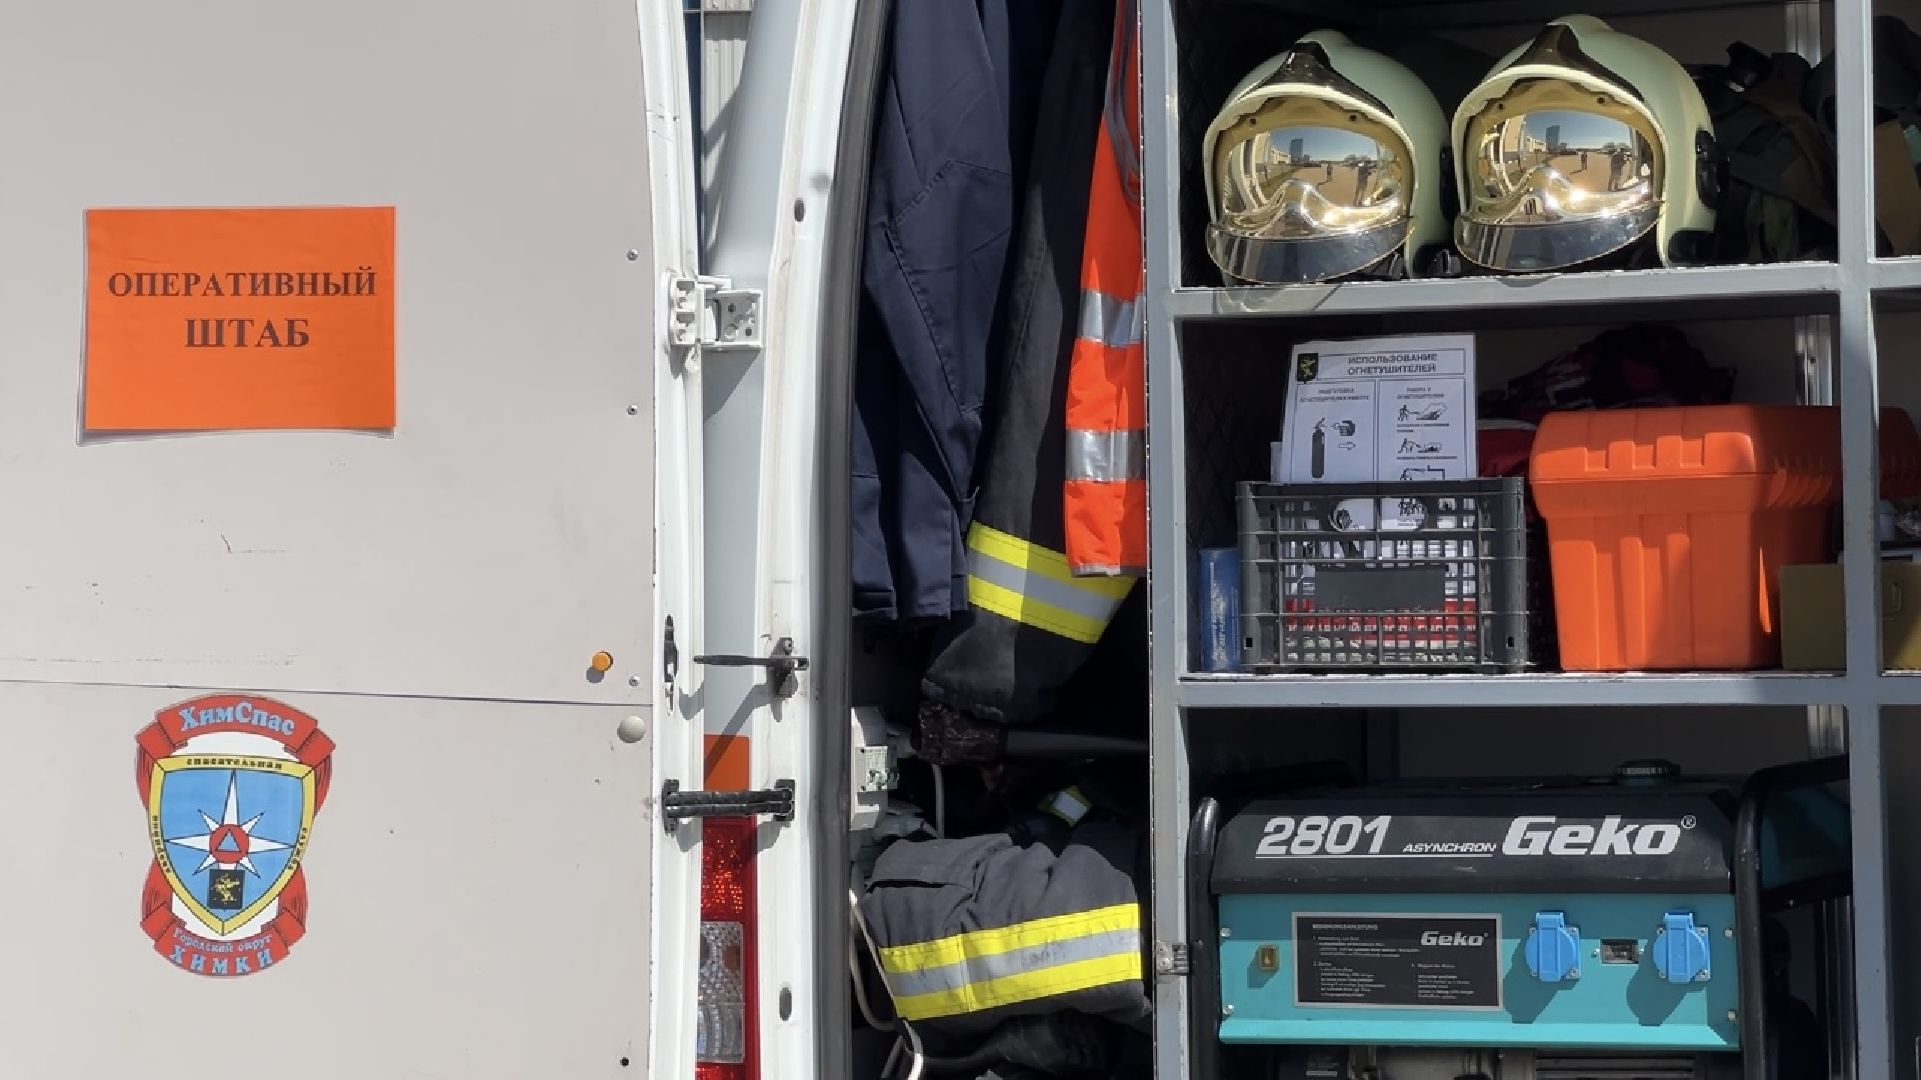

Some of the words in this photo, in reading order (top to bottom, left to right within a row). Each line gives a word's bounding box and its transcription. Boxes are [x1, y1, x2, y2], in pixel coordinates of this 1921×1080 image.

[108, 265, 378, 297] ОПЕРАТИВНЫЙ
[184, 318, 310, 348] ШТАБ
[1347, 363, 1437, 376] ОГНЕТУШИТЕЛЕЙ
[1348, 353, 1438, 364] ИСПОЛЬЗОВАНИЕ
[178, 700, 295, 736] ХимСпас
[1255, 815, 1393, 856] 2801
[1402, 842, 1497, 853] ASYNCHRON
